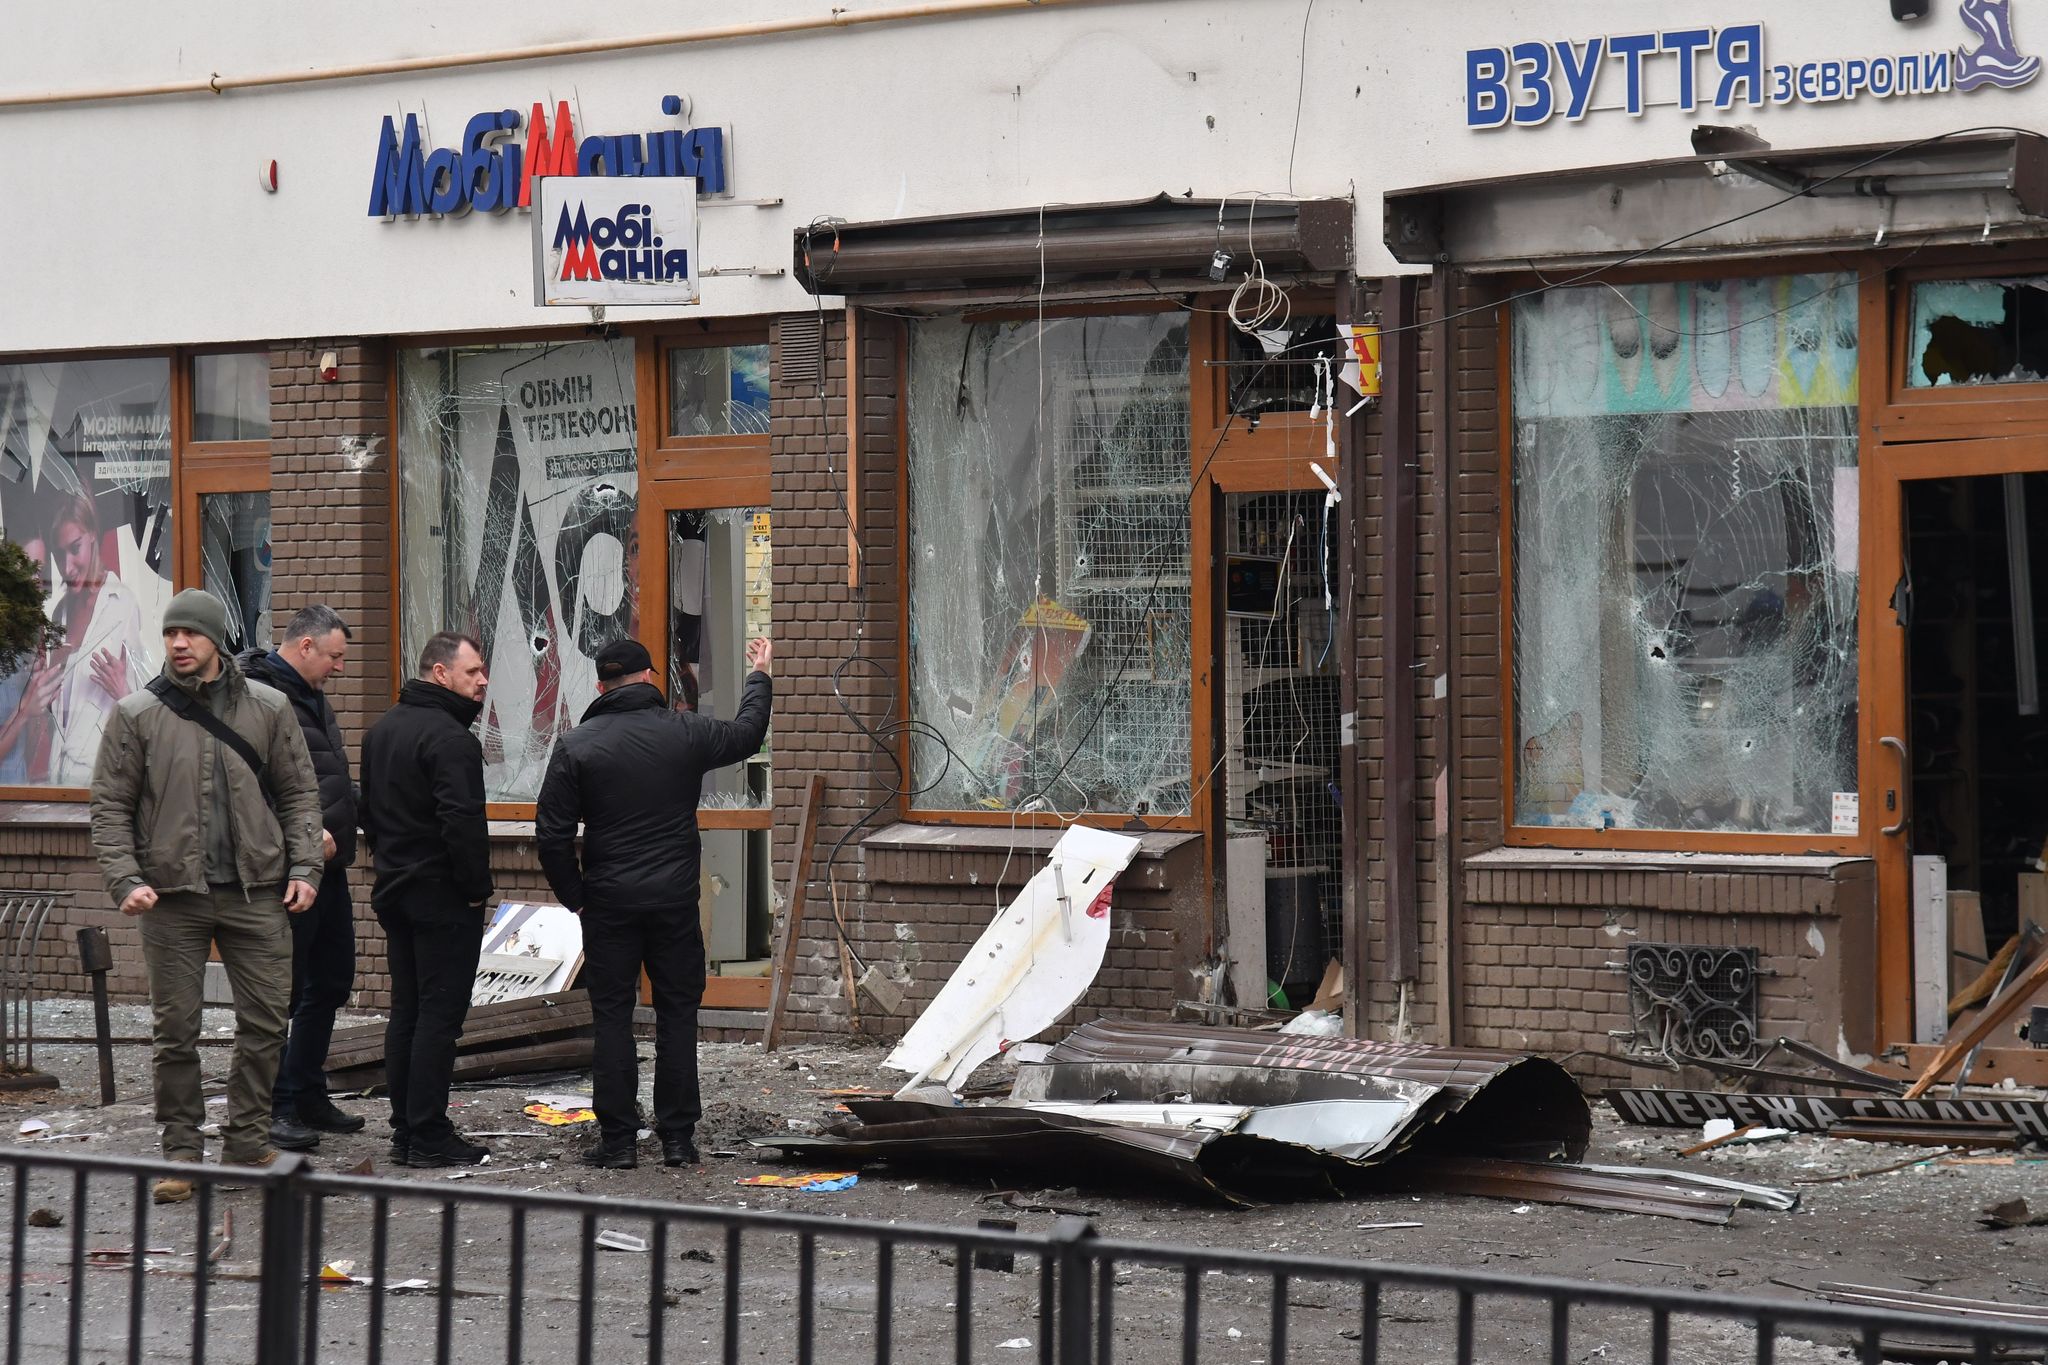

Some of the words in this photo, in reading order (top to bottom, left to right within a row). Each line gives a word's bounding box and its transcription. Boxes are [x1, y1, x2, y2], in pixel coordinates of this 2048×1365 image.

[1466, 23, 1763, 127] ВЗУТТЯ
[553, 200, 652, 250] Мобі
[560, 235, 688, 281] Манія
[520, 374, 593, 409] ОБМІН
[1619, 1090, 1842, 1130] МЕРЕЖА
[1853, 1099, 2048, 1136] СМАЧН
